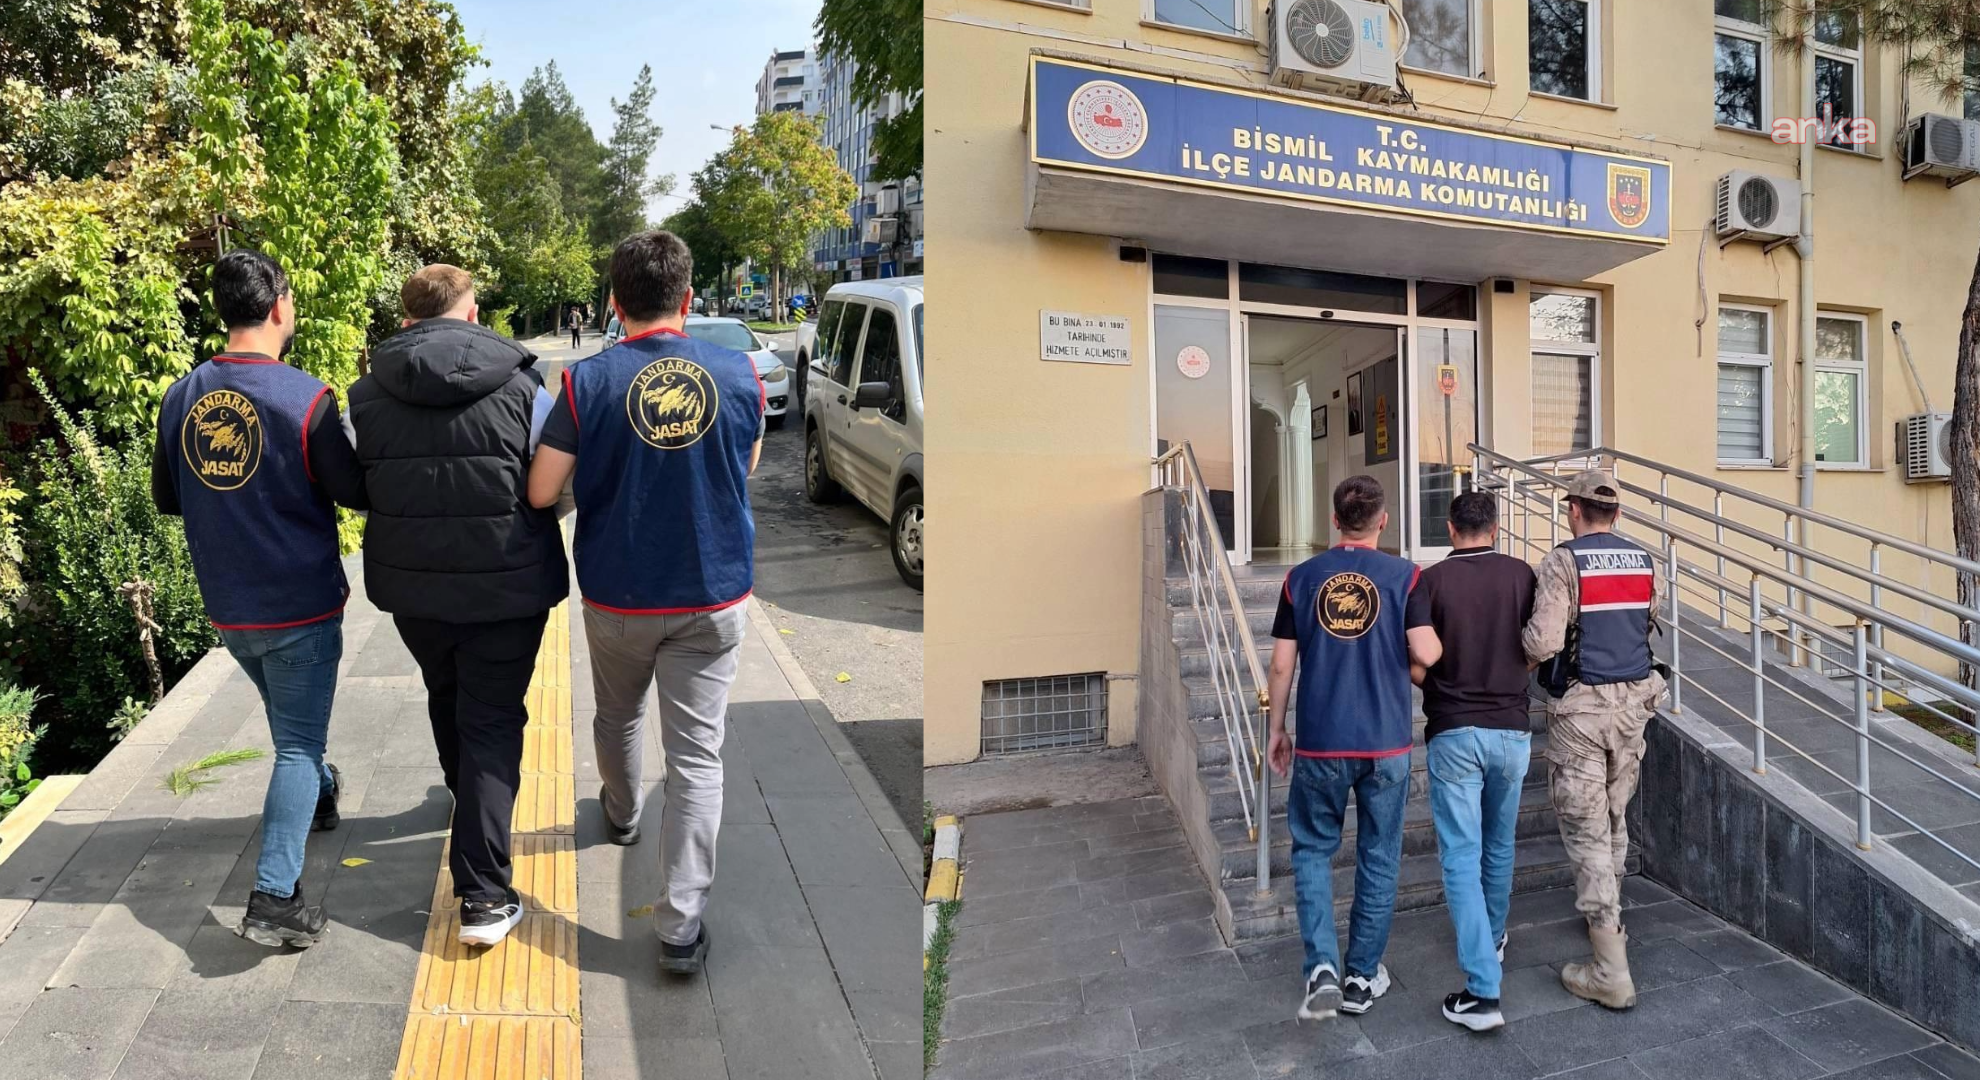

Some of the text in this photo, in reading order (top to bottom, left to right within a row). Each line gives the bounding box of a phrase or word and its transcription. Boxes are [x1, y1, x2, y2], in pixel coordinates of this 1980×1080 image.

[1377, 125, 1426, 151] T.C.
[1233, 126, 1549, 192] BİSMİL KAYMAKAMLIĞI
[1182, 143, 1250, 179] İLÇE
[1260, 161, 1412, 199] JANDARMA
[1421, 183, 1587, 221] KOMUTANLIĞI
[1049, 316, 1060, 326] BU
[636, 360, 702, 389] JANDARMA
[191, 394, 257, 427] JANDARMA
[650, 420, 699, 440] JASAT
[201, 460, 245, 476] JASAT
[1585, 554, 1646, 569] JANDARMA
[1325, 574, 1372, 592] JANDARMA
[1329, 618, 1365, 630] JASAT
